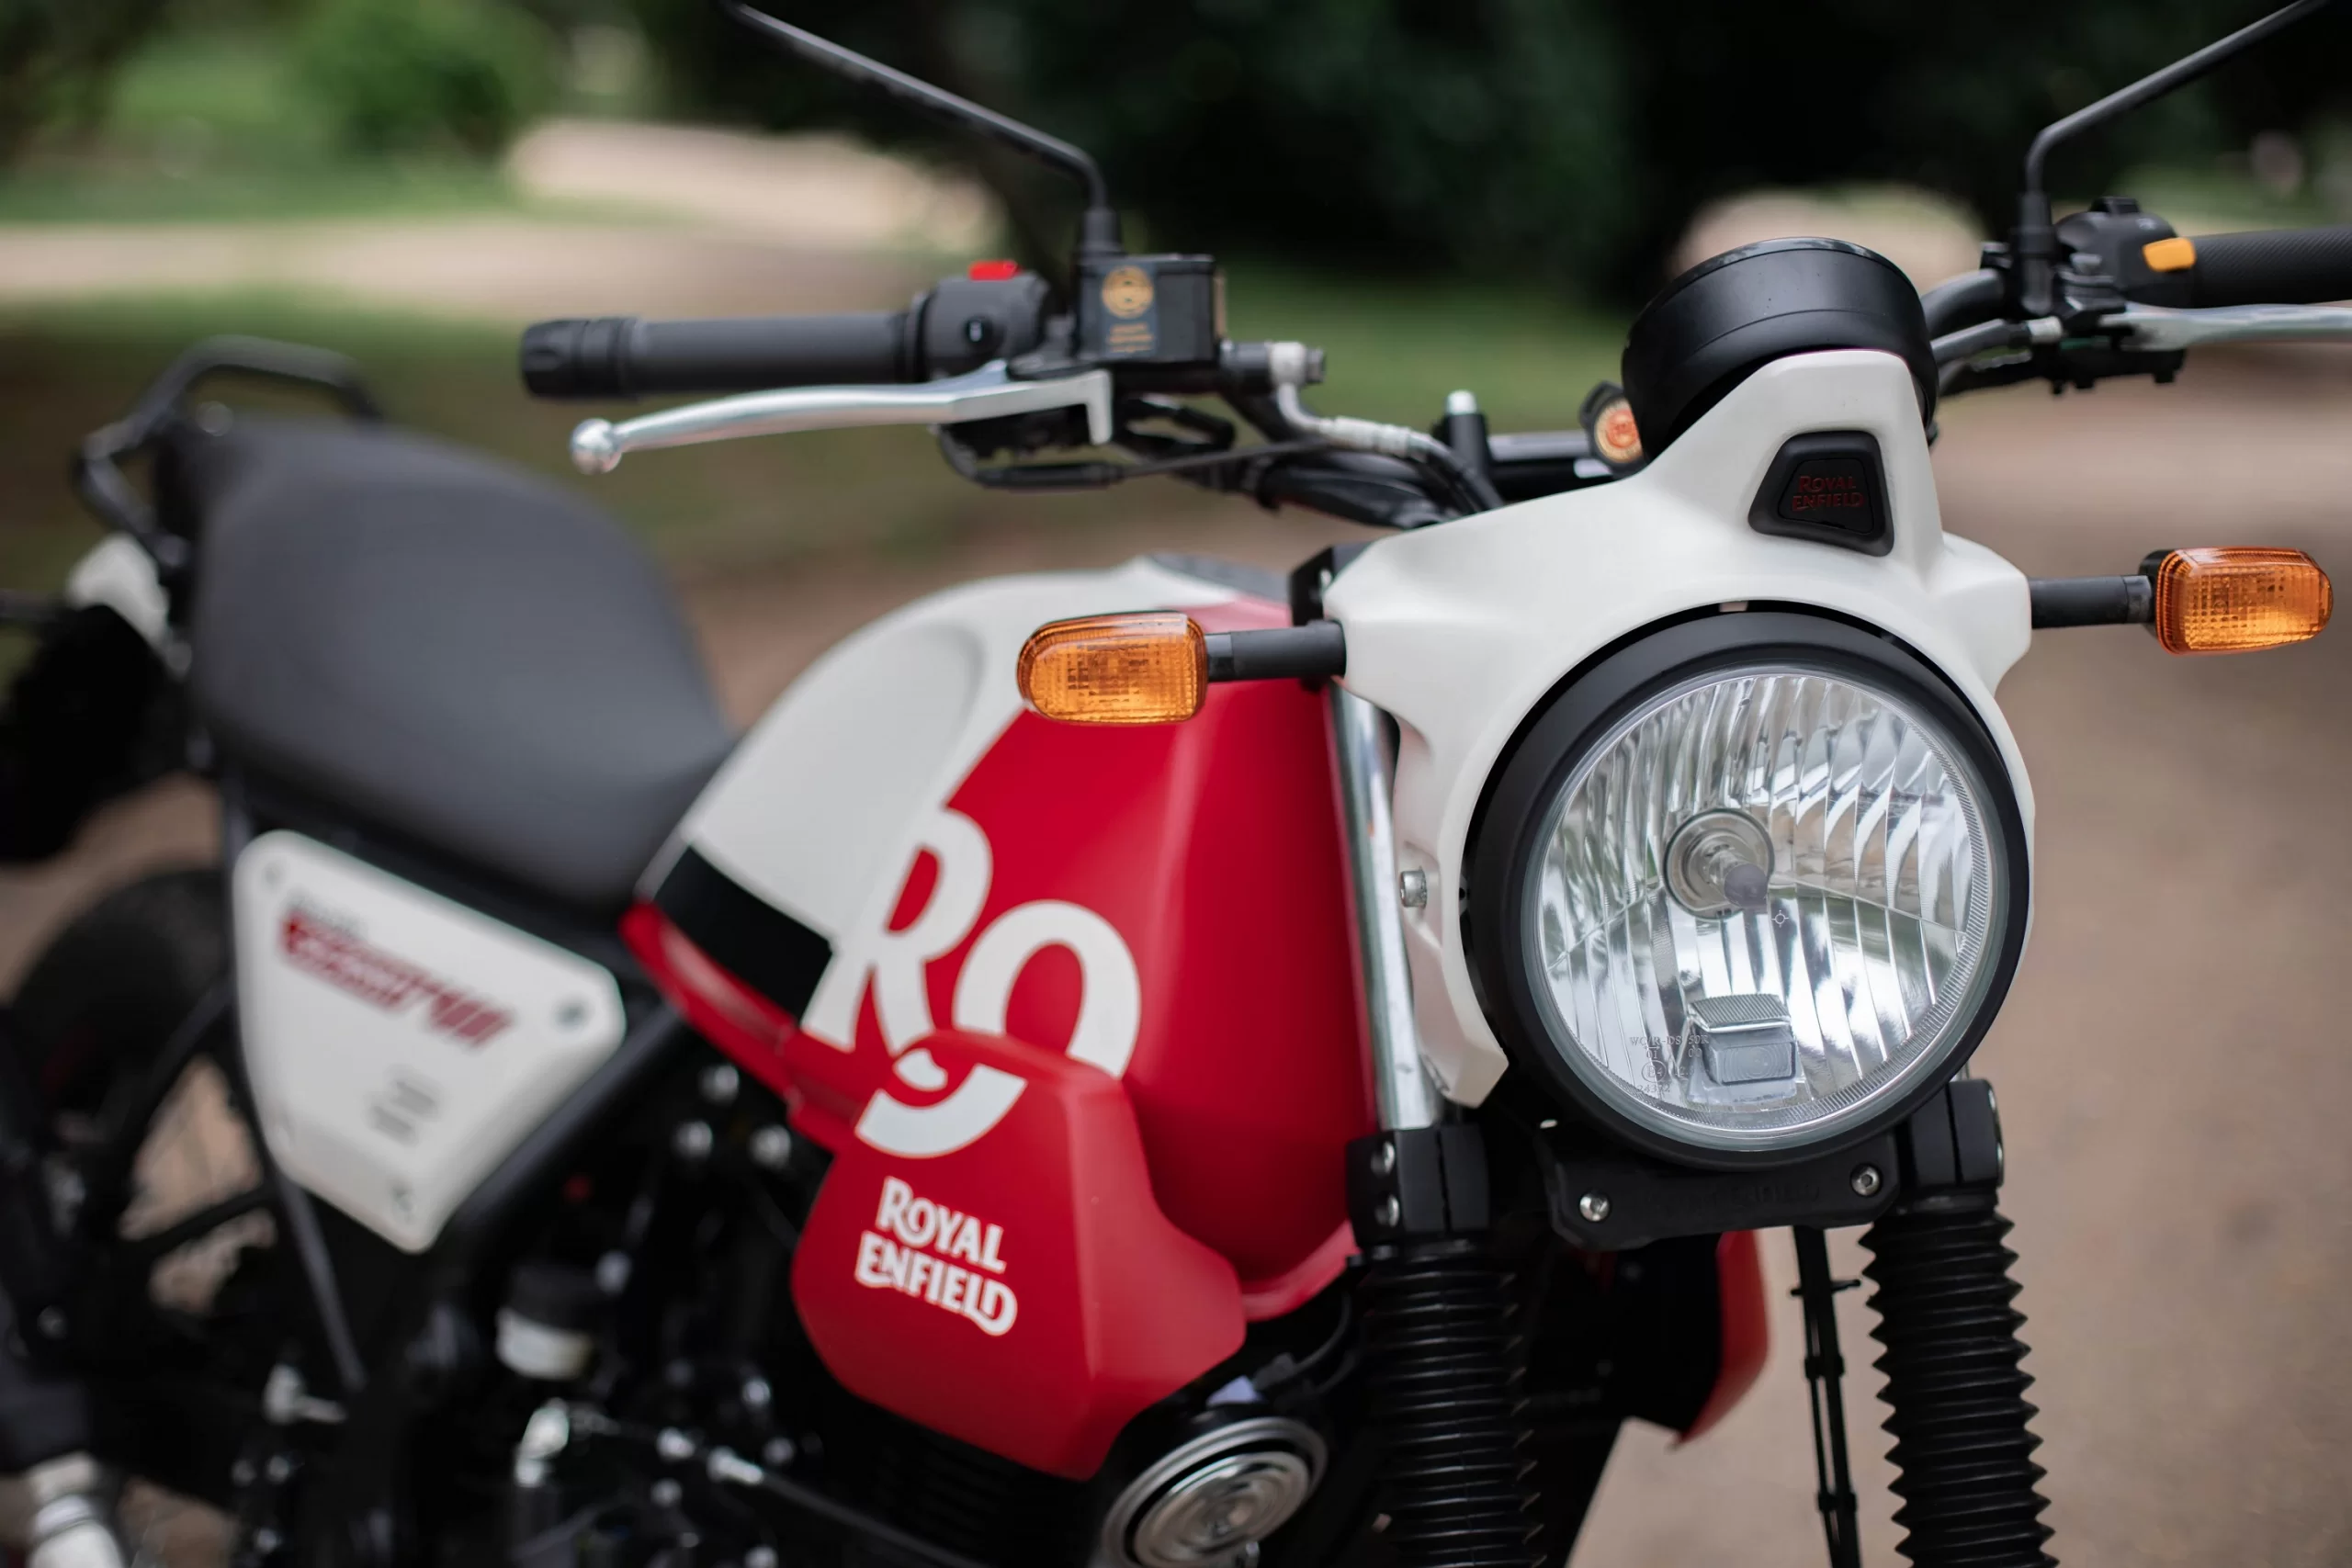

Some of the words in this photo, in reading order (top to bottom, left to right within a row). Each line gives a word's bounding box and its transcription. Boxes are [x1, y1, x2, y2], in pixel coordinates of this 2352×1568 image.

[1792, 493, 1865, 512] ENFIELD
[1799, 476, 1857, 492] ROYAL
[876, 1177, 1007, 1274] ROYAL
[855, 1231, 1018, 1337] ENFIELD
